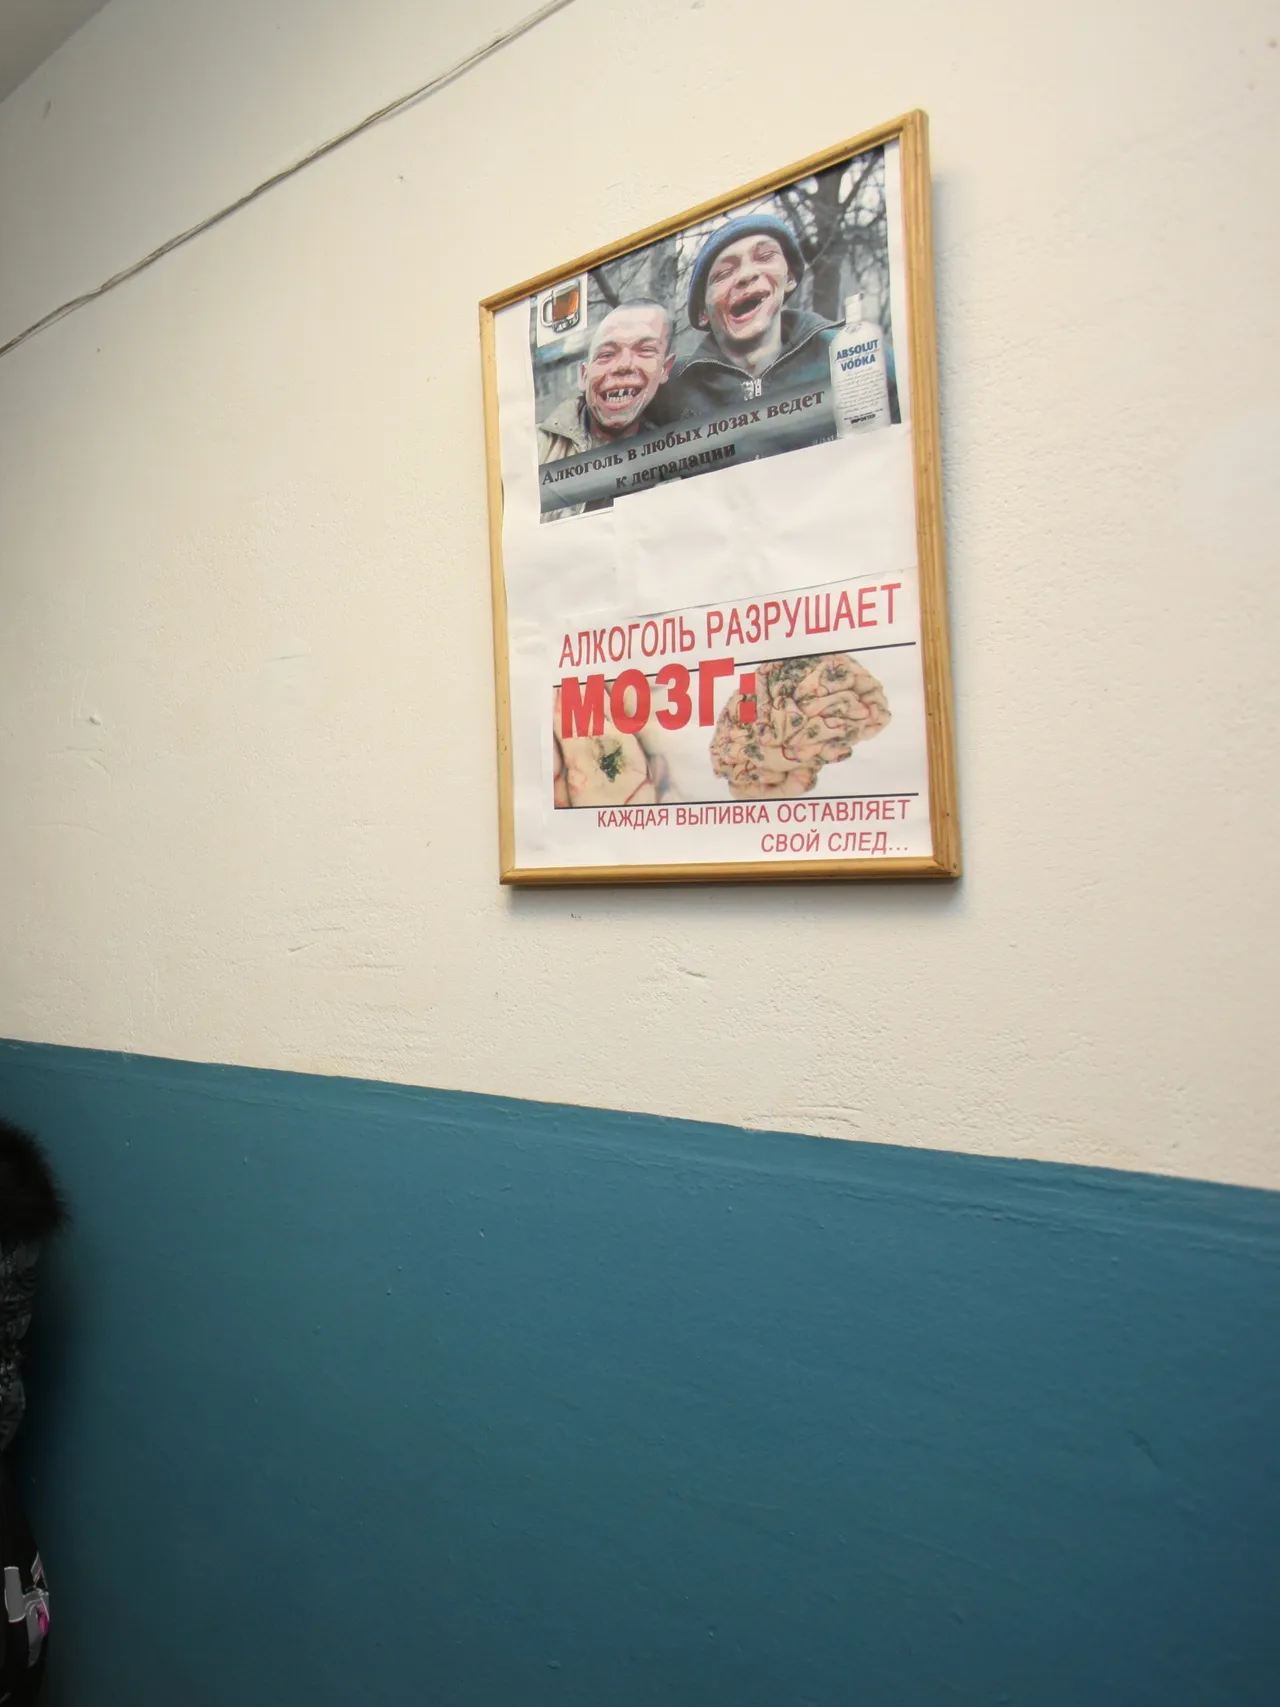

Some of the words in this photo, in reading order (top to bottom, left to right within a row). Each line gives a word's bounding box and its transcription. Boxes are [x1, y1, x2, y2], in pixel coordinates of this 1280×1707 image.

[837, 339, 879, 360] ABSOLUT
[841, 354, 876, 371] VODKA
[542, 454, 623, 485] Алкоголь
[628, 449, 637, 461] в
[641, 427, 702, 456] любых
[707, 410, 761, 438] дозах
[767, 391, 825, 418] ведет
[616, 477, 627, 489] к
[631, 444, 736, 486] деградации
[559, 616, 695, 668] АЛКОГОЛЬ
[706, 583, 901, 648] РАЗРУШАЕТ
[597, 808, 669, 830] КАЖДАЯ
[676, 804, 770, 826] ВЫПИВКА
[777, 799, 911, 823] ОСТАВЛЯЕТ
[761, 829, 820, 853] СВОЙ
[827, 831, 908, 855] СЛЕД...
